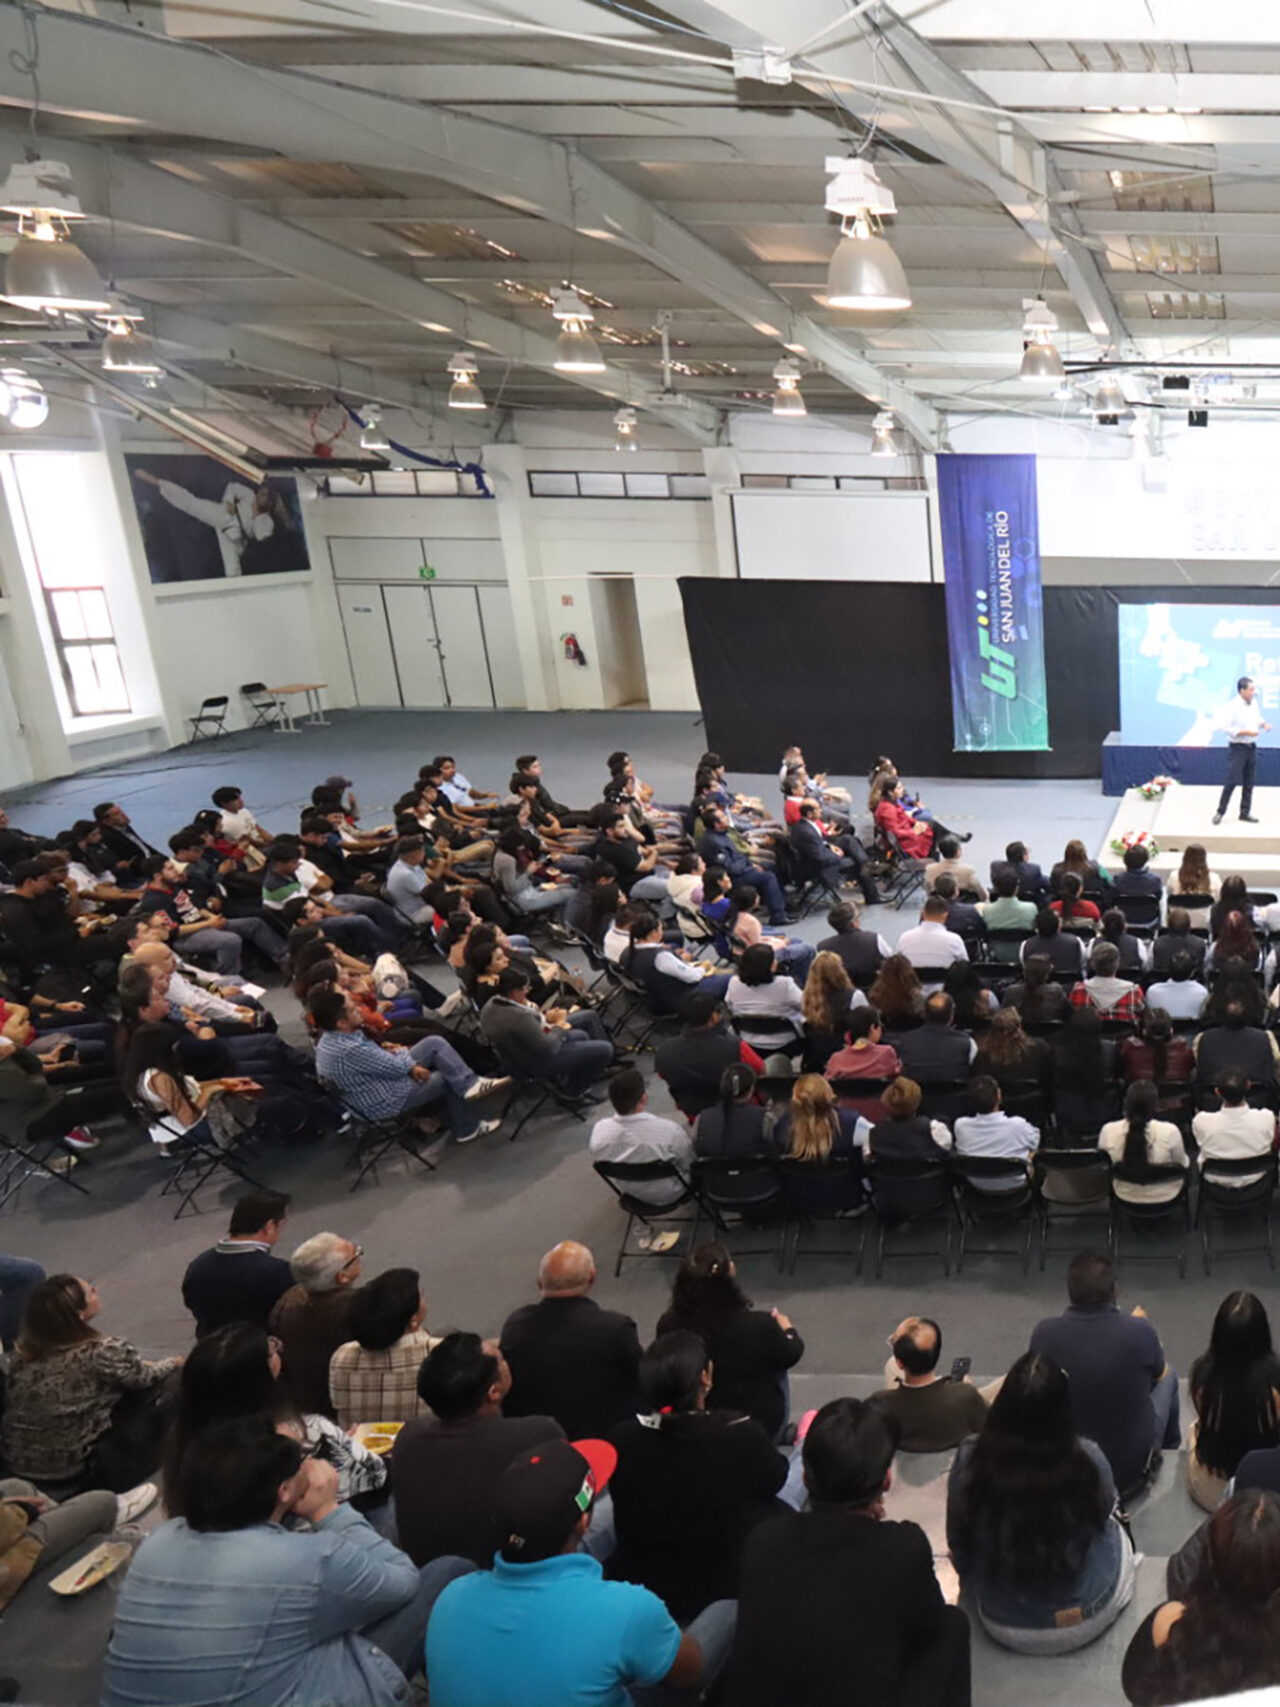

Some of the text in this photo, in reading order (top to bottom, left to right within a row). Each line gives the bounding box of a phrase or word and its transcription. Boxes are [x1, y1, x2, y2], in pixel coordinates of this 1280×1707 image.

[993, 511, 1013, 643] SAN JUAN DEL RÍO
